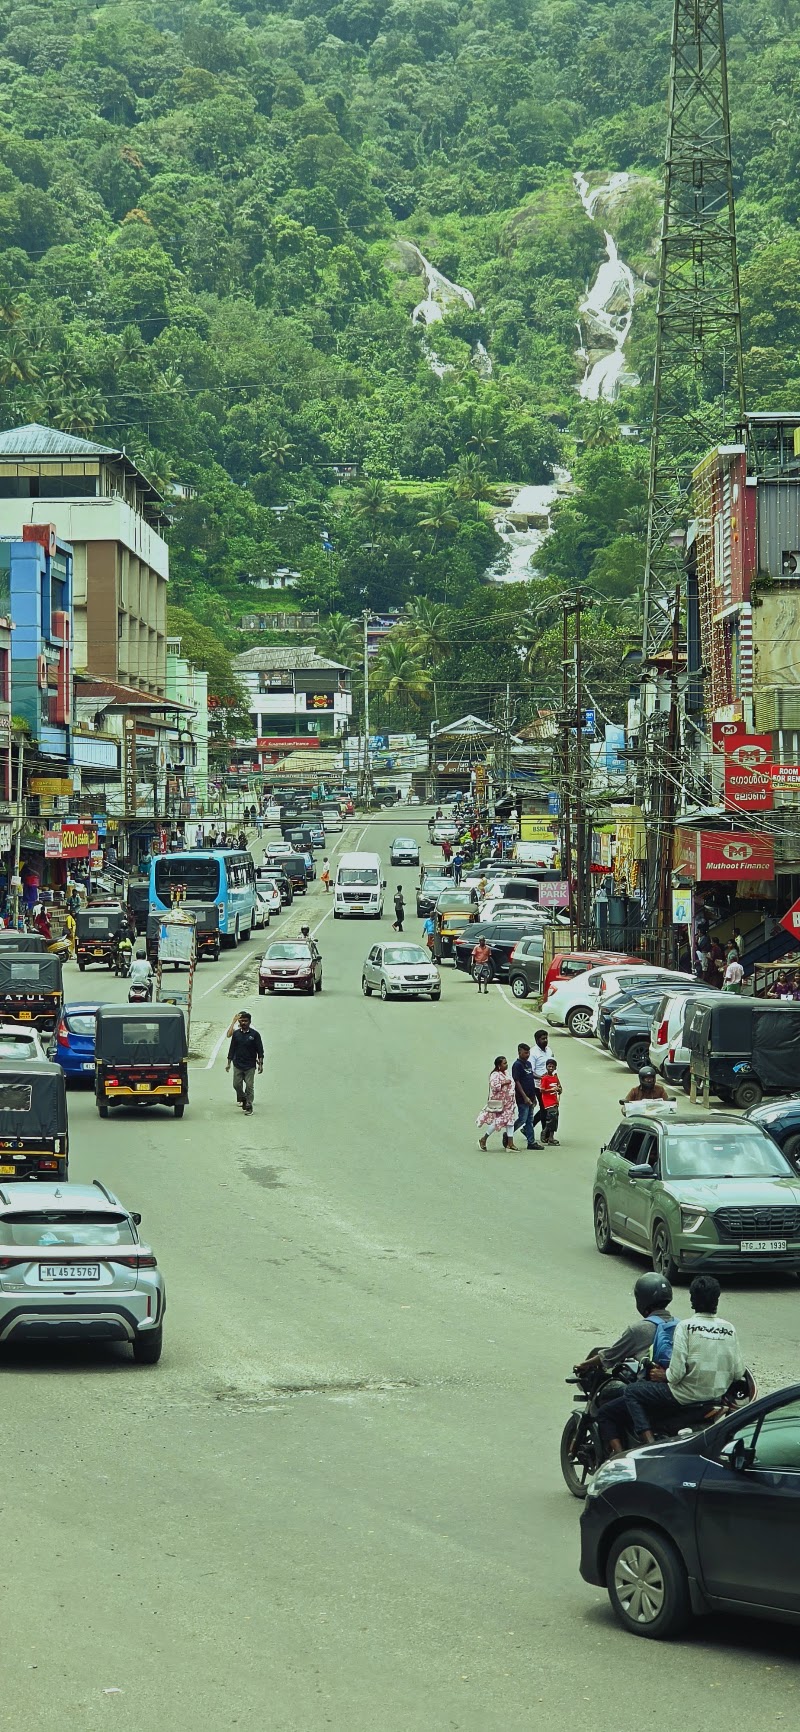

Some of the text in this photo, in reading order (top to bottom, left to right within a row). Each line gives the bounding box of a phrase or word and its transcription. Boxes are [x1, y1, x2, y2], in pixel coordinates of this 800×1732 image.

[779, 767, 799, 776] ROOM
[770, 1241, 786, 1250] 1939
[46, 1267, 97, 1277] KL 45 Z 5767
